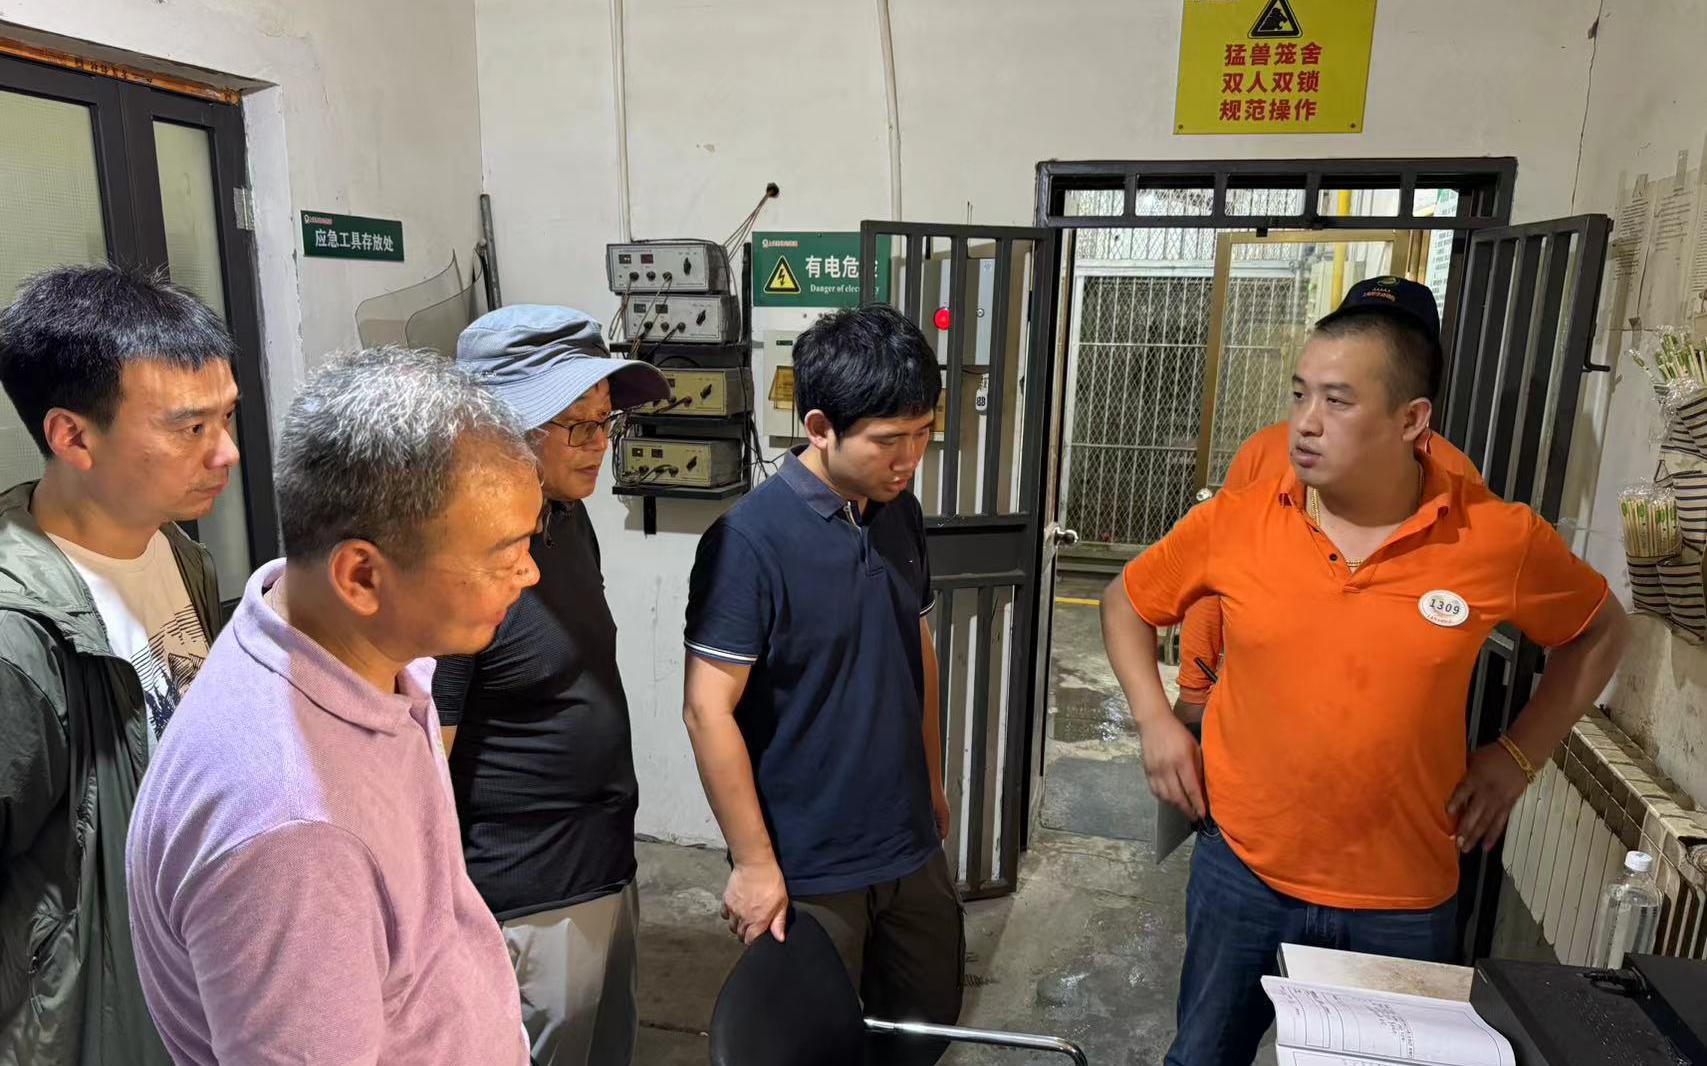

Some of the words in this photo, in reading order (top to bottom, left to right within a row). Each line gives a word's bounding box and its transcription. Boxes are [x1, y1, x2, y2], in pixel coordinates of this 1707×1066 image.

[1224, 41, 1323, 67] 猛兽笼舍
[1221, 70, 1320, 94] 双人双锁
[1219, 98, 1318, 122] 规范操作
[315, 228, 395, 252] 应急工具存放处
[805, 255, 878, 279] 有电危
[810, 284, 836, 294] Danger
[836, 283, 844, 293] of
[1429, 599, 1460, 615] 1309
